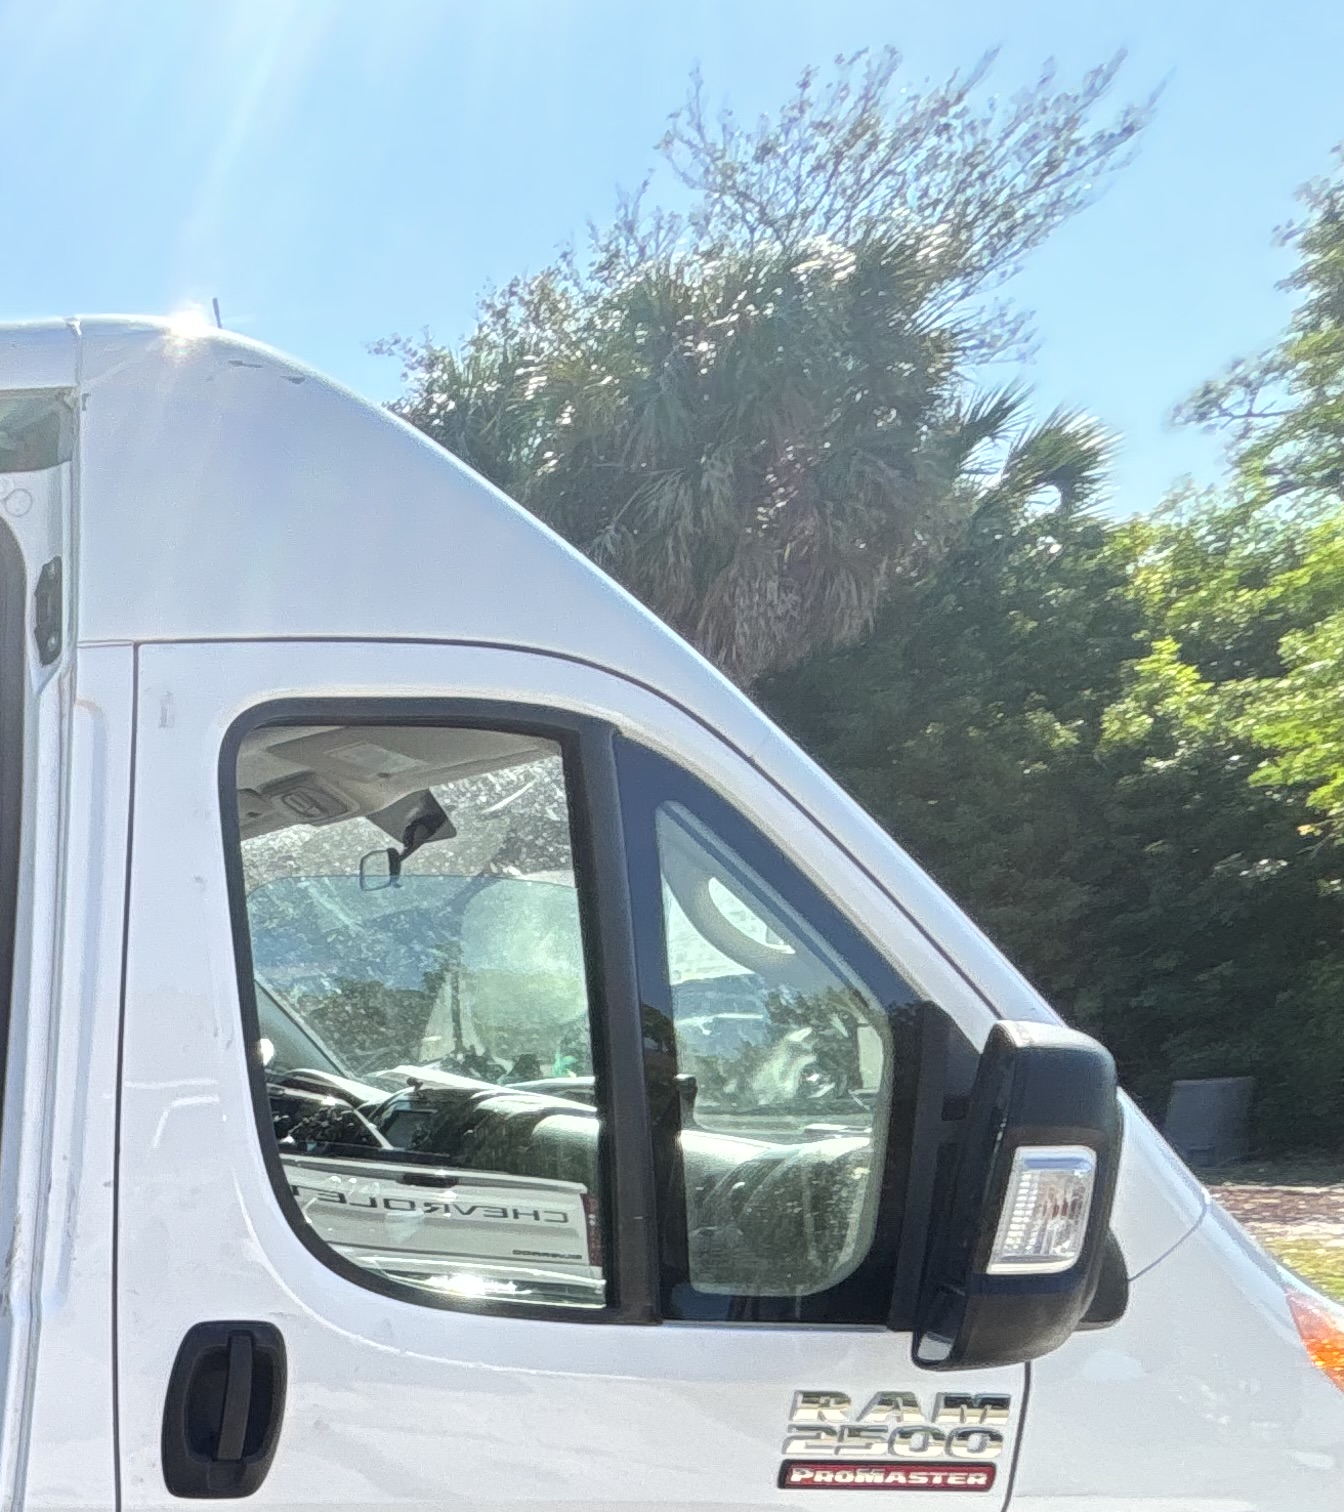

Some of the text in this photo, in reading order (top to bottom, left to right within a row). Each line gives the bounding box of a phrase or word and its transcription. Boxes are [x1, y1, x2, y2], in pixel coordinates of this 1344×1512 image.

[788, 1390, 1012, 1425] RAM
[781, 1424, 1004, 1459] 2500
[789, 1467, 988, 1487] PROMASTER
